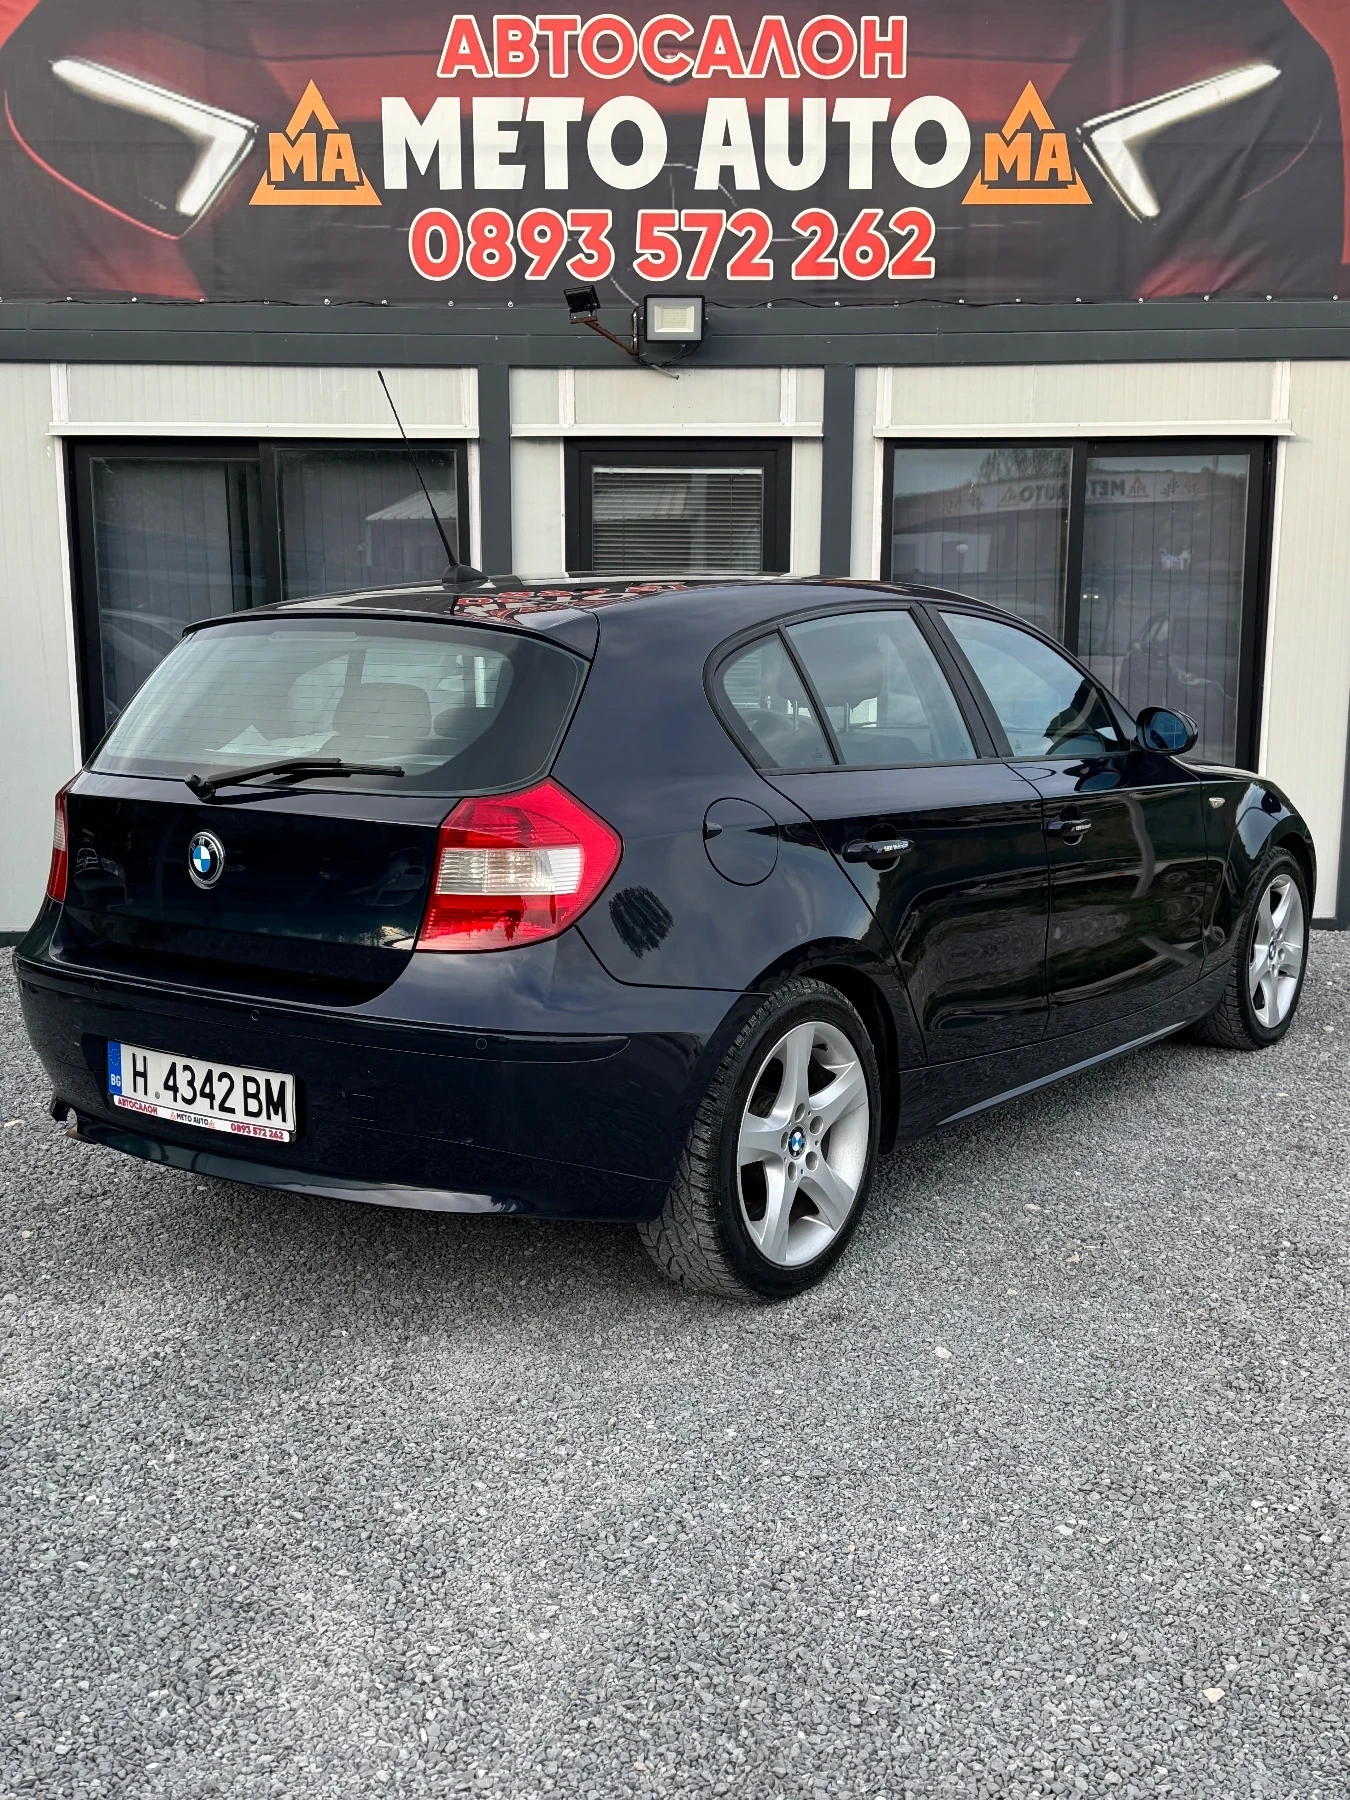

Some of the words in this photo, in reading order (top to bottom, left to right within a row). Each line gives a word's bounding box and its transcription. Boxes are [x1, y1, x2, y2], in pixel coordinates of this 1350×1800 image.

[437, 14, 907, 80] АВТОСАЛОН
[268, 132, 360, 182] MA
[381, 95, 668, 190] METO
[694, 95, 971, 191] AUTO
[984, 132, 1073, 182] MA
[408, 207, 616, 281] 0893
[632, 208, 773, 281] 572
[791, 207, 935, 281] 262
[110, 1073, 121, 1087] BG
[163, 1061, 237, 1115] 4342
[242, 1074, 287, 1123] BM
[117, 1097, 158, 1115] АВТОСАЛОН
[176, 1112, 192, 1122] METO
[193, 1116, 209, 1126] AUTO
[230, 1122, 251, 1134] 0893
[252, 1126, 267, 1137] 572
[268, 1129, 284, 1140] 262
